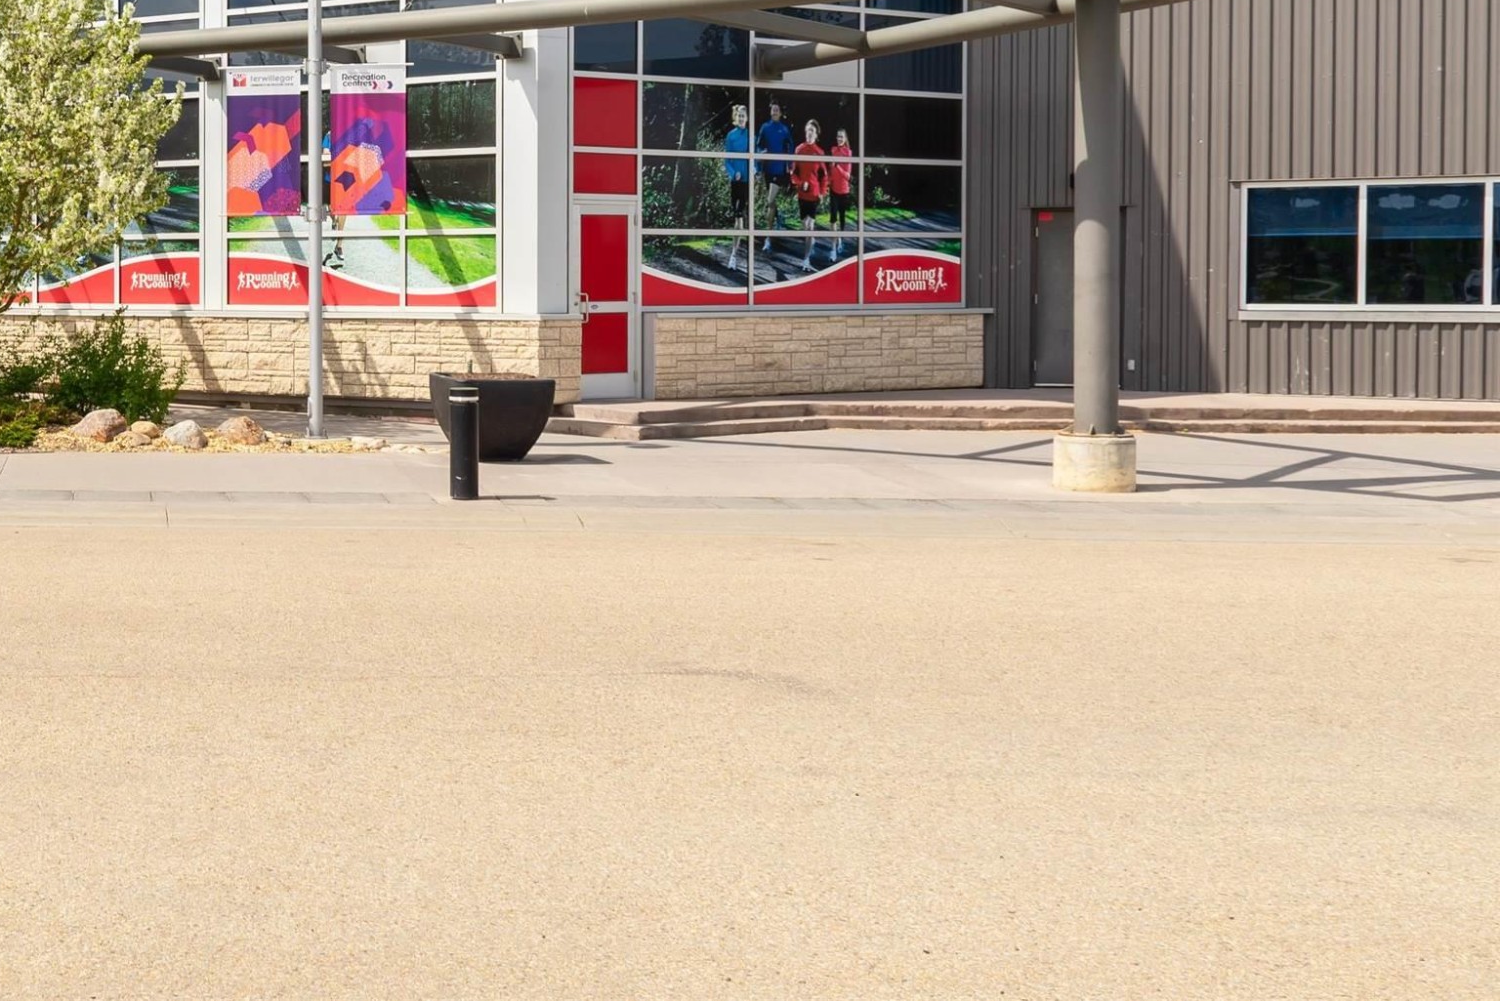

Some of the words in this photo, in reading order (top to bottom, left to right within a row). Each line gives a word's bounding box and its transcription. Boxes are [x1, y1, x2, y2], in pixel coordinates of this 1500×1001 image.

[341, 73, 387, 81] Recreation
[138, 271, 181, 289] Running
[246, 271, 290, 289] Running
[885, 266, 937, 291] Running
